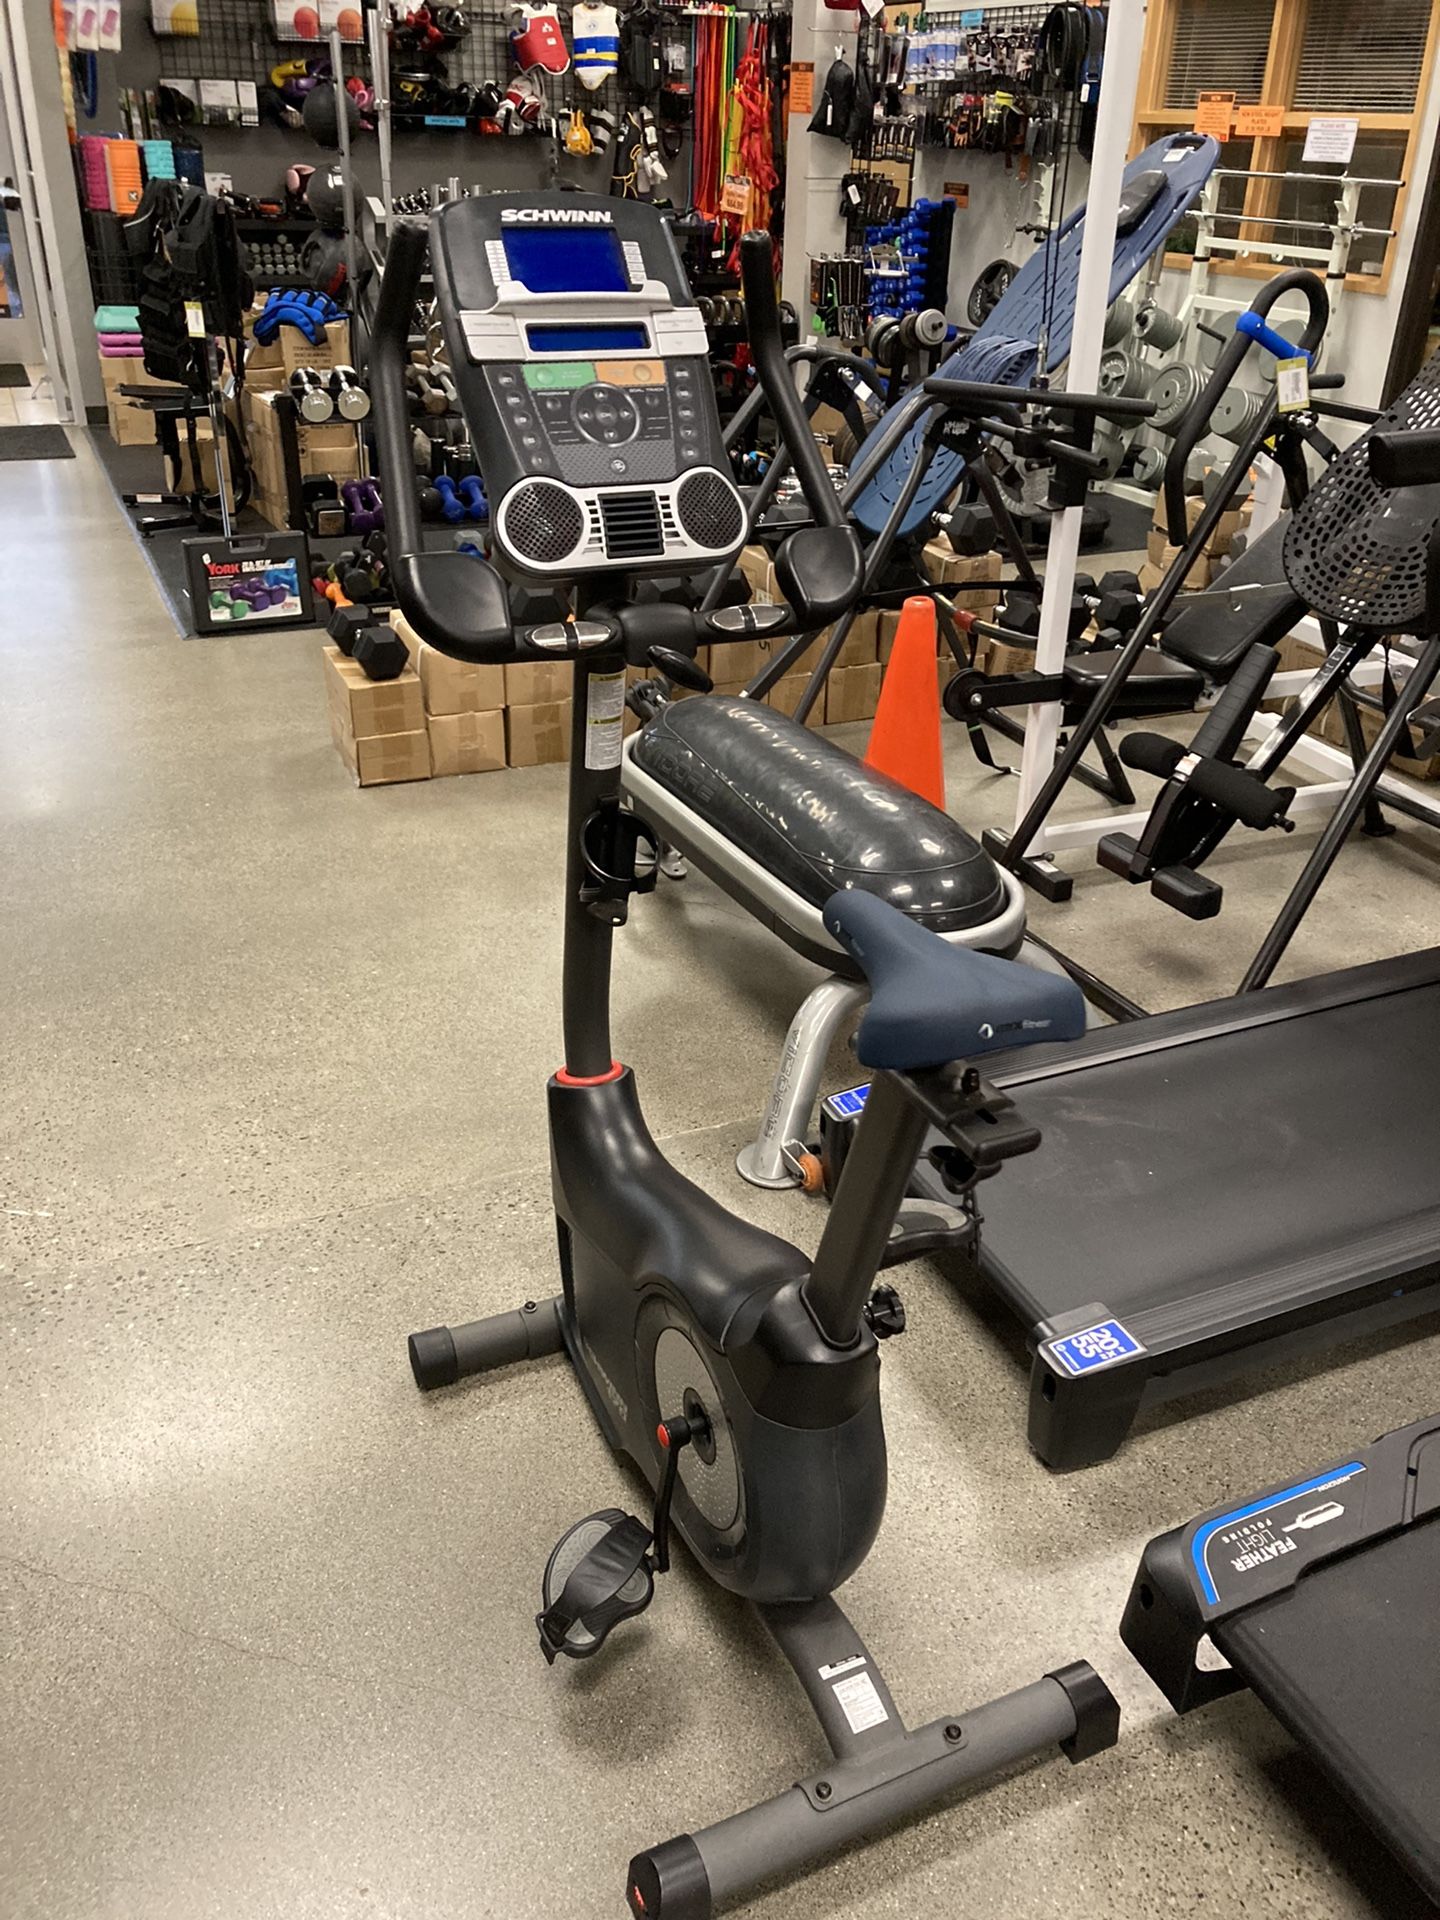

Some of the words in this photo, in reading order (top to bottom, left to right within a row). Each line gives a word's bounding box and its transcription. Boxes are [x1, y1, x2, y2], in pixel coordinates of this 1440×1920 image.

[501, 209, 612, 223] SCHWINN
[207, 563, 240, 575] YORK
[1221, 1518, 1273, 1543] FOLDING
[1236, 1530, 1276, 1555] LIGHT
[1230, 1536, 1298, 1572] FEATHER
